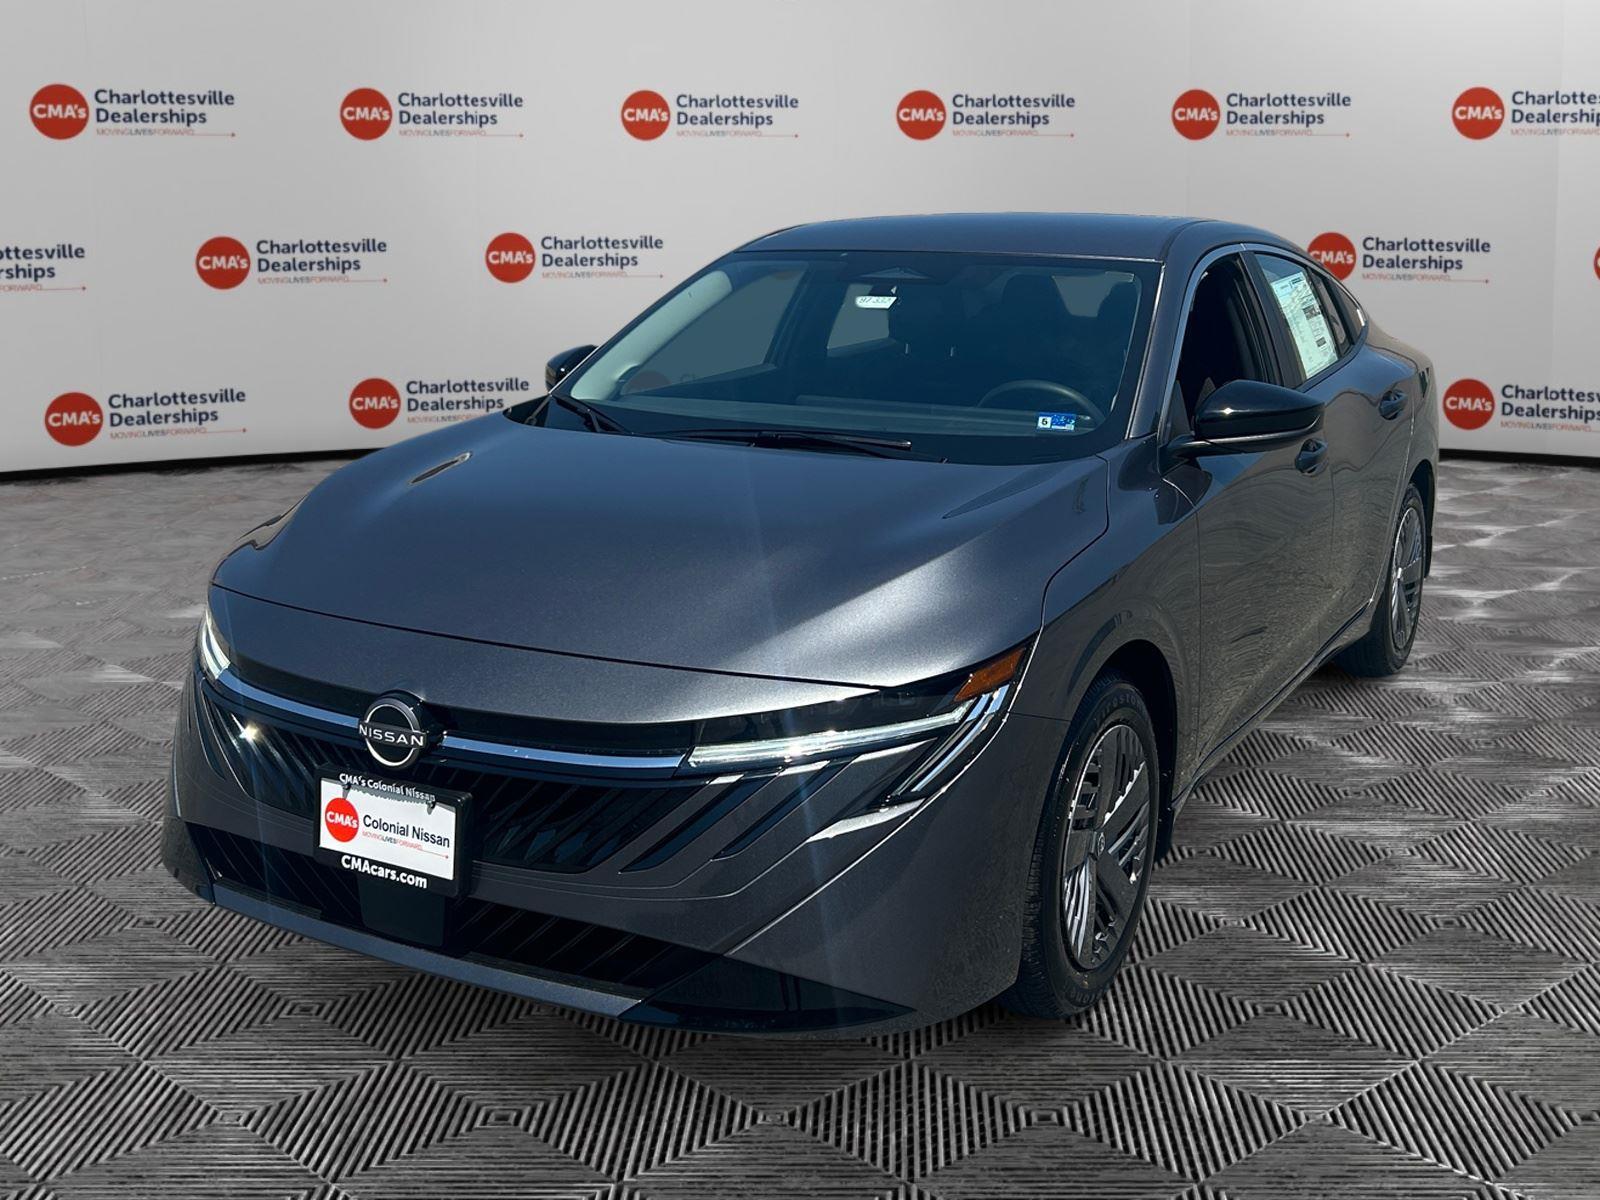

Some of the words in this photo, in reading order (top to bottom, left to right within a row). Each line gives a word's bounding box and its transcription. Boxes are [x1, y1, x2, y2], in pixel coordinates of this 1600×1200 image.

[95, 89, 235, 106] Charlottesville
[398, 92, 523, 107] Charlottesville
[676, 94, 799, 109] Charlottesville
[952, 93, 1076, 108] Charlottesville
[1226, 92, 1351, 107] Charlottesville
[32, 103, 87, 119] CMA's
[95, 107, 207, 128] Dealerships
[342, 106, 391, 121] CMA's
[398, 109, 498, 129] Dealerships
[623, 107, 669, 123] CMA's
[898, 107, 945, 122] CMA's
[1174, 107, 1218, 122] CMA's
[1226, 110, 1325, 128] Dealerships
[1453, 105, 1504, 121] CMA's
[676, 111, 774, 129] Dealerships
[952, 111, 1050, 129] Dealerships
[256, 239, 387, 255] Charlottesville
[541, 235, 664, 250] Charlottesville
[1362, 236, 1491, 253] Charlottesville
[198, 255, 249, 270] CMA's
[257, 256, 361, 275] Dealerships
[487, 250, 534, 265] CMA's
[541, 252, 639, 271] Dealerships
[1362, 253, 1463, 274] Dealerships
[405, 378, 529, 395] Charlottesville
[108, 389, 246, 410] Charlottesville
[351, 396, 399, 411] CMA's
[407, 396, 504, 412] Dealerships
[1445, 396, 1493, 412] CMA's
[47, 410, 101, 427] CMA's
[109, 408, 219, 428] Dealerships
[359, 724, 424, 747] NISSAN
[339, 773, 367, 787] CMA's
[367, 779, 405, 796] Colonial
[405, 787, 436, 802] Nissan
[326, 811, 359, 829] CMA's
[363, 814, 410, 838] Colonial
[411, 825, 451, 849] Nissan
[341, 854, 428, 889] CMAcars.com
